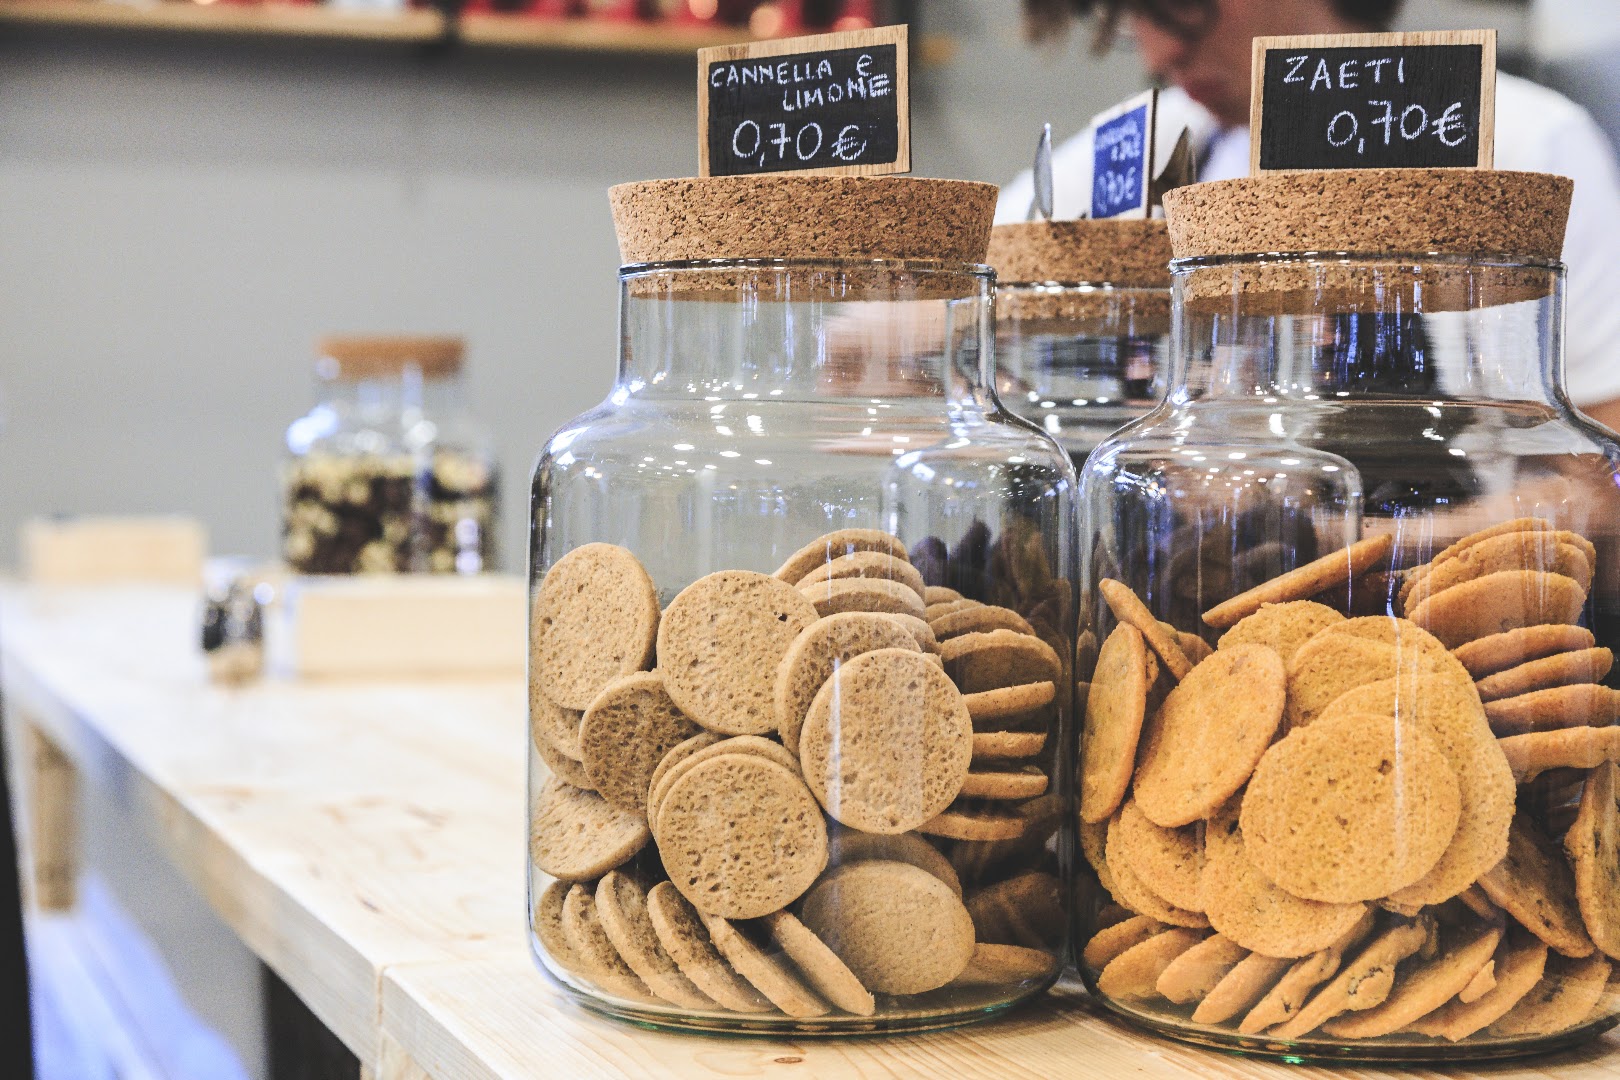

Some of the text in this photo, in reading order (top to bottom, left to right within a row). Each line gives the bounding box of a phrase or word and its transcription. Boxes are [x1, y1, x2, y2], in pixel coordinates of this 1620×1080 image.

[711, 59, 832, 87] CANNELLA
[1283, 55, 1404, 91] ZAETI
[783, 74, 891, 111] LIMONE
